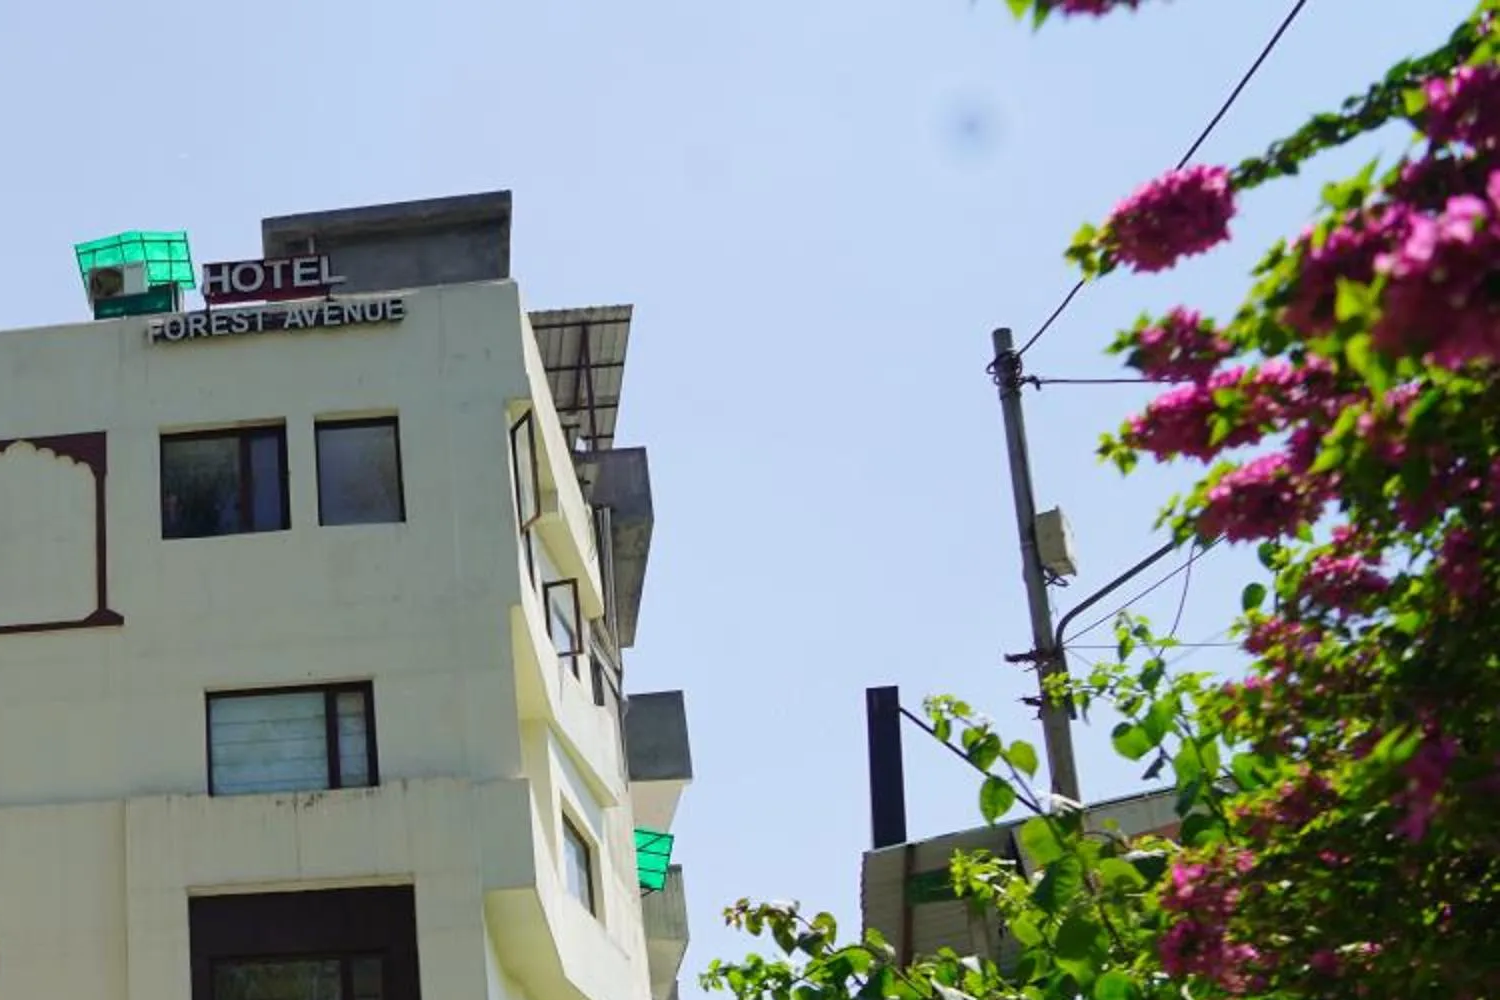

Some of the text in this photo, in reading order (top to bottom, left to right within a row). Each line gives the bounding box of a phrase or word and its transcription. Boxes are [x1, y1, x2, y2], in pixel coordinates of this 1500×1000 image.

[203, 255, 345, 296] HOTEL
[147, 298, 404, 343] FOREST AVENUE
